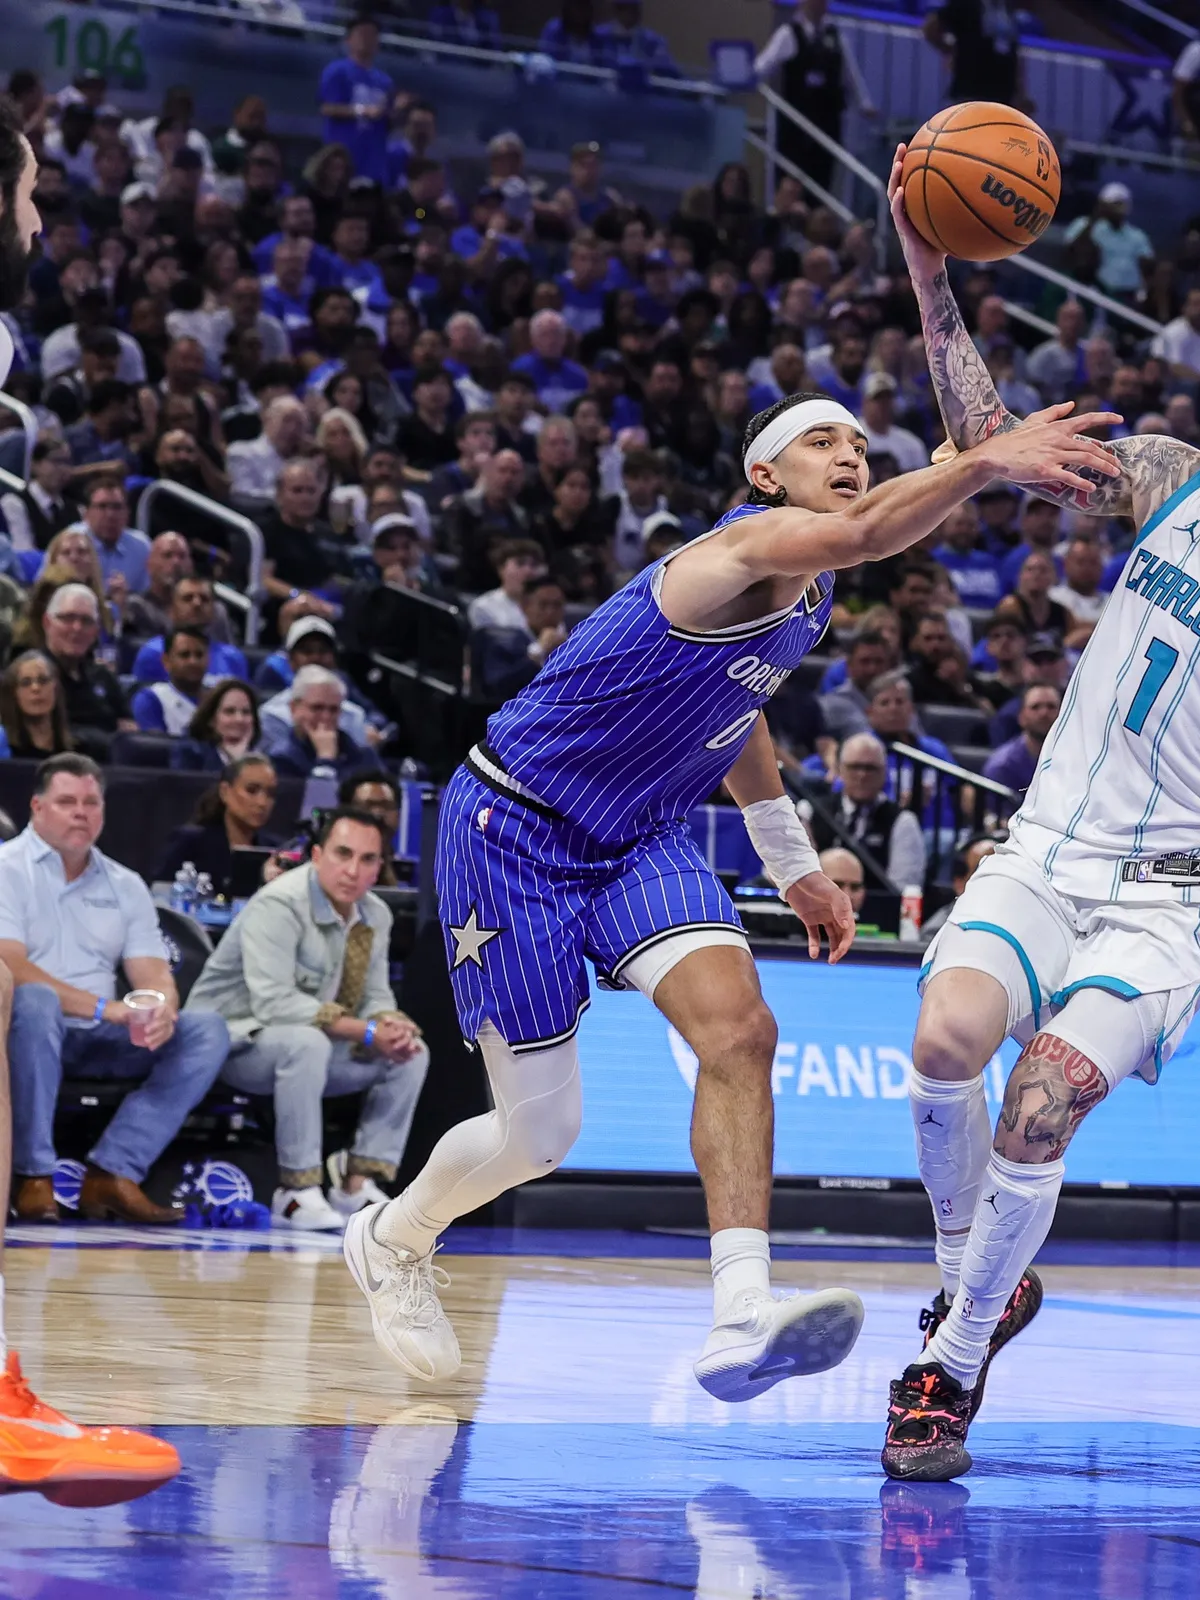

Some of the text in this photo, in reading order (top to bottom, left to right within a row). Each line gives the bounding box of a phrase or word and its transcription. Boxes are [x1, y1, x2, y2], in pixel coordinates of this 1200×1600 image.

[46, 15, 143, 78] 106
[981, 172, 1051, 237] Wilson
[1123, 636, 1180, 737] 1
[705, 708, 760, 750] 0
